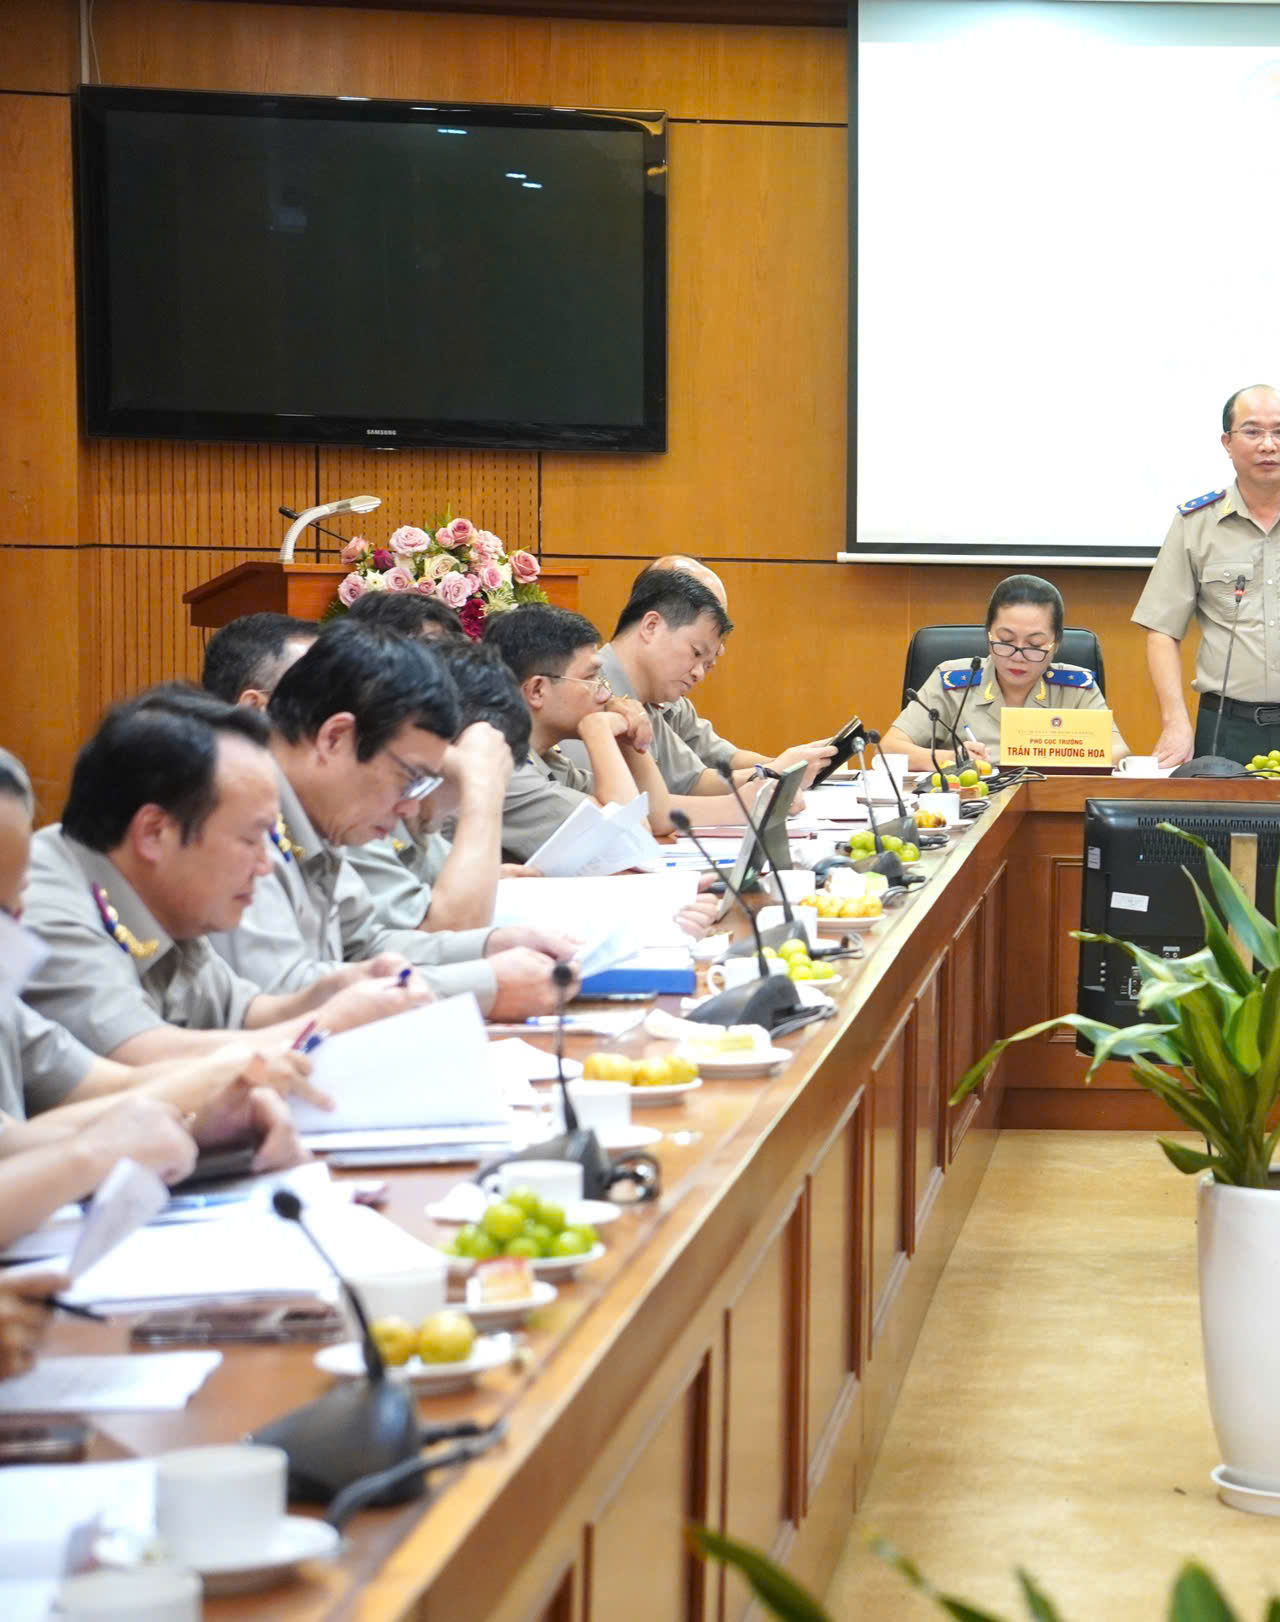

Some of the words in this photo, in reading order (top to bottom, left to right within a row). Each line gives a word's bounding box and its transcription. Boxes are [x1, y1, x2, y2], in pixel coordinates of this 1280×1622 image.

[1033, 747, 1046, 758] THỊ
[1049, 747, 1085, 758] PHƯƠNG
[1087, 749, 1105, 758] HOA
